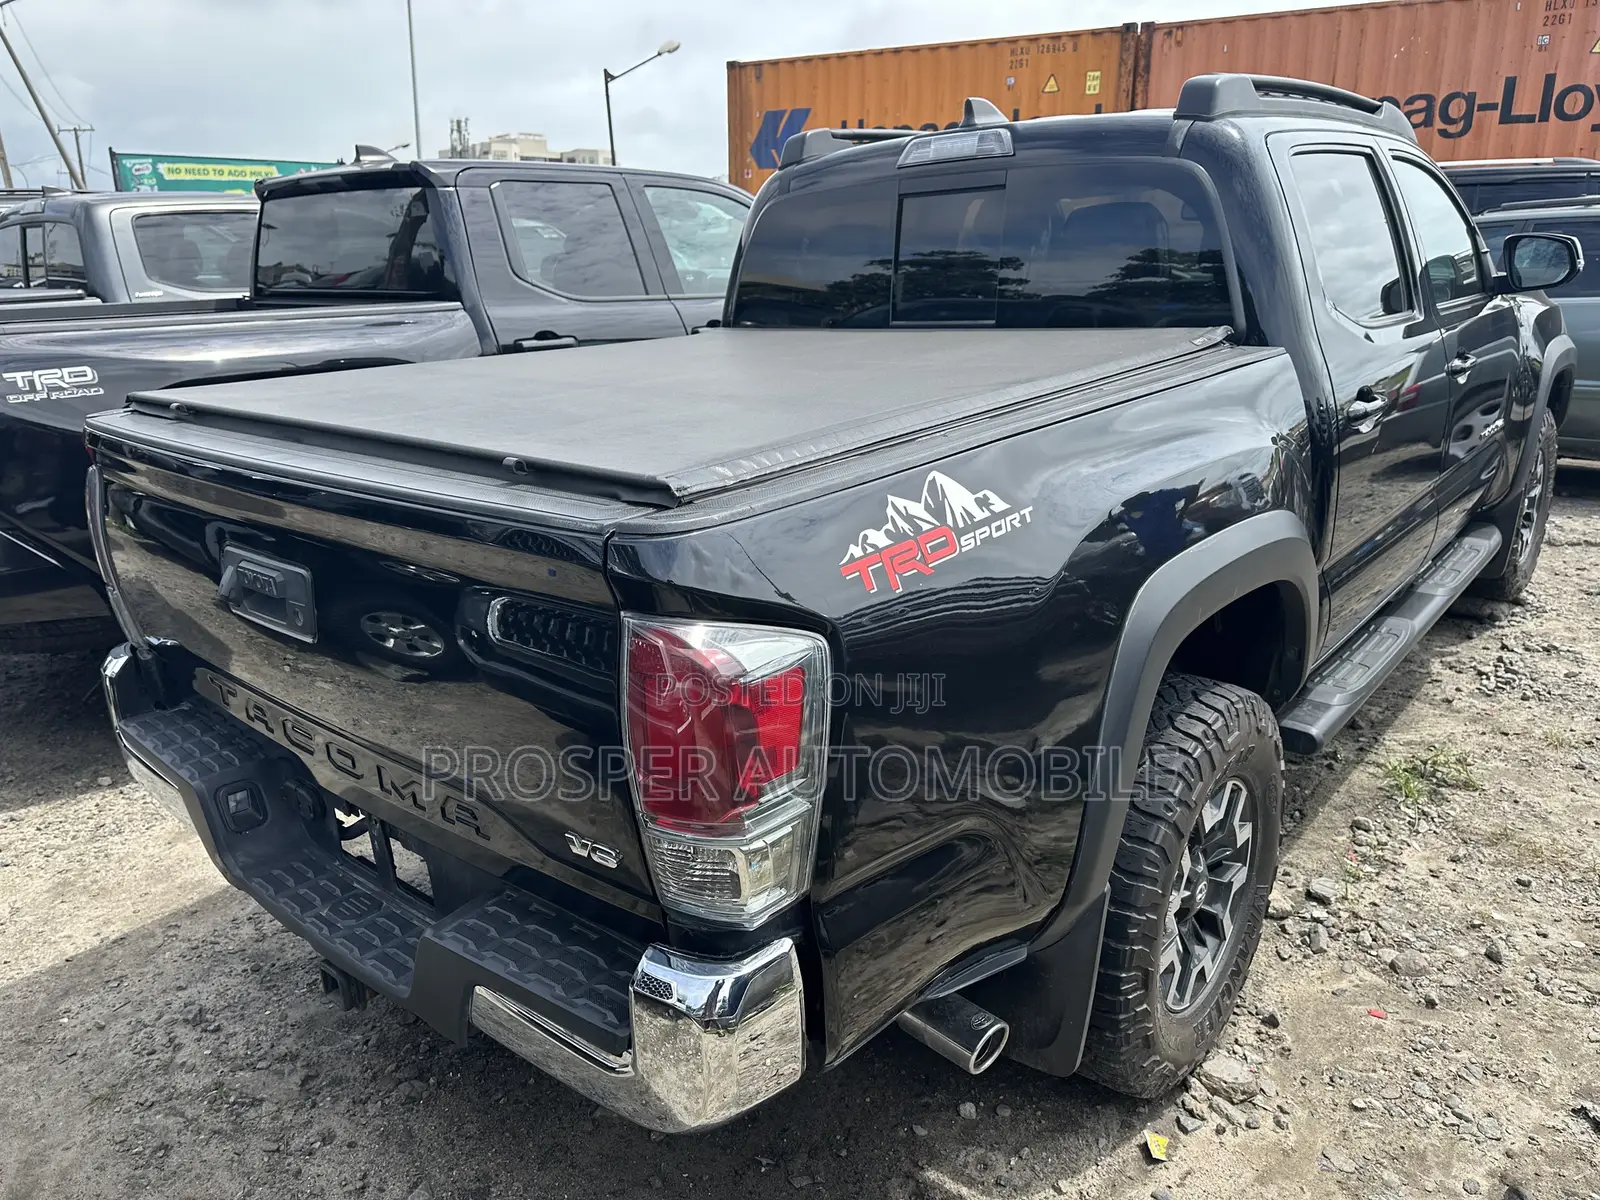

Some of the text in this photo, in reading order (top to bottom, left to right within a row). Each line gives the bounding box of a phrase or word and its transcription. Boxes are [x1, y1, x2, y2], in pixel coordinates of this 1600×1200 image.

[1542, 13, 1572, 26] 22G1
[167, 167, 182, 175] NO
[184, 168, 209, 176] NEED
[211, 168, 225, 176] TO
[227, 169, 247, 177] ADD
[2, 365, 98, 392] TRD
[6, 387, 105, 403] OFF ROAD
[840, 505, 1034, 593] TRD SPORT
